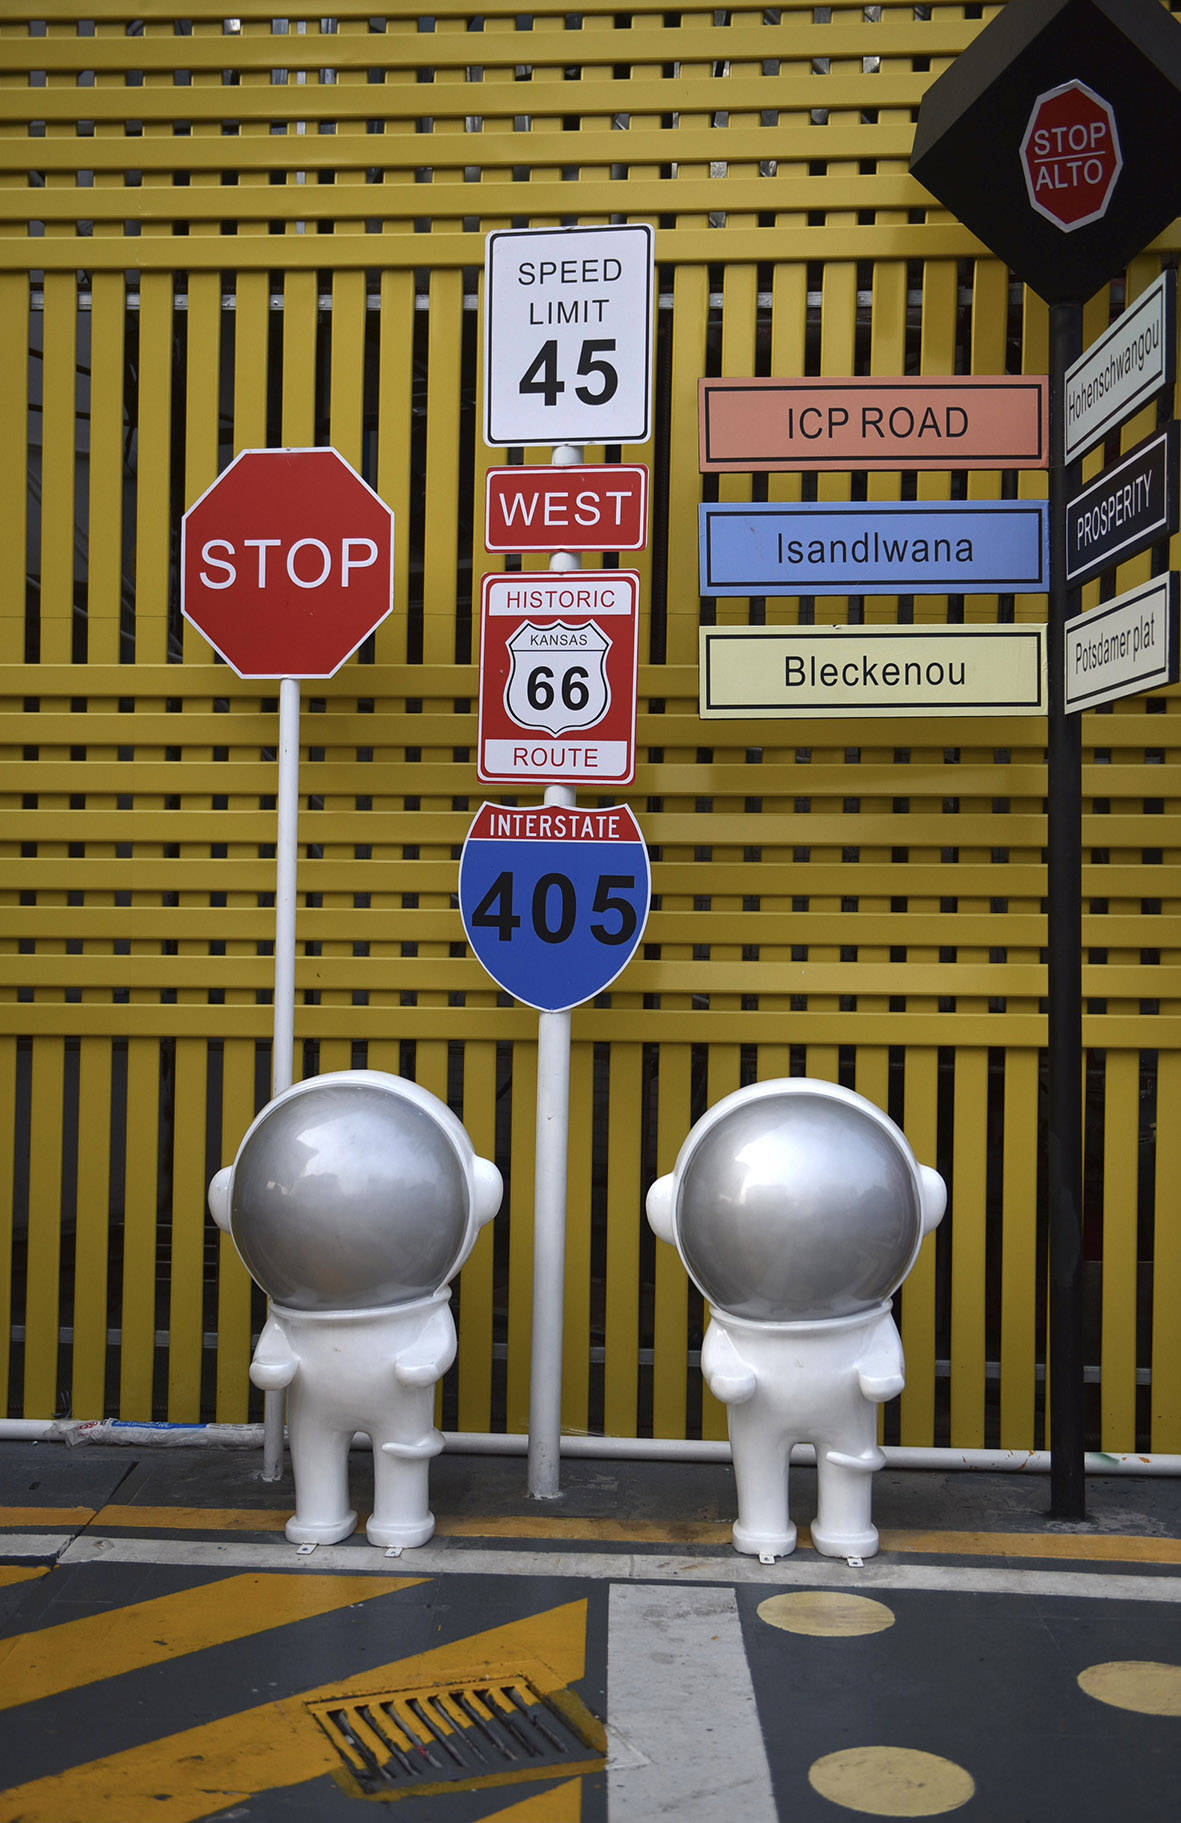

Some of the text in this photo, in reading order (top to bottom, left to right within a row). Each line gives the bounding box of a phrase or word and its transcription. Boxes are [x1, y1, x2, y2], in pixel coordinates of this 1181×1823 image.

[1034, 122, 1106, 155] STOP
[1036, 159, 1103, 192] ALTO
[518, 258, 622, 286] SPEED
[529, 299, 610, 325] LIMIT
[519, 338, 619, 407] 45
[1068, 319, 1159, 426] Hohenschwangou
[788, 406, 968, 439] ICP ROAD
[499, 491, 632, 526] WEST
[1077, 469, 1152, 551] PROSPERITY
[200, 537, 379, 590] STOP
[777, 532, 974, 564] Isandlwana
[506, 589, 615, 610] HISTORIC
[529, 633, 588, 647] KANSAS
[1075, 612, 1155, 675] Potsdamer plat
[785, 655, 966, 686] Bleckenou
[526, 665, 590, 711] 66
[513, 747, 599, 768] ROUTE
[490, 814, 620, 839] INTERSTATE
[471, 871, 637, 946] 405
